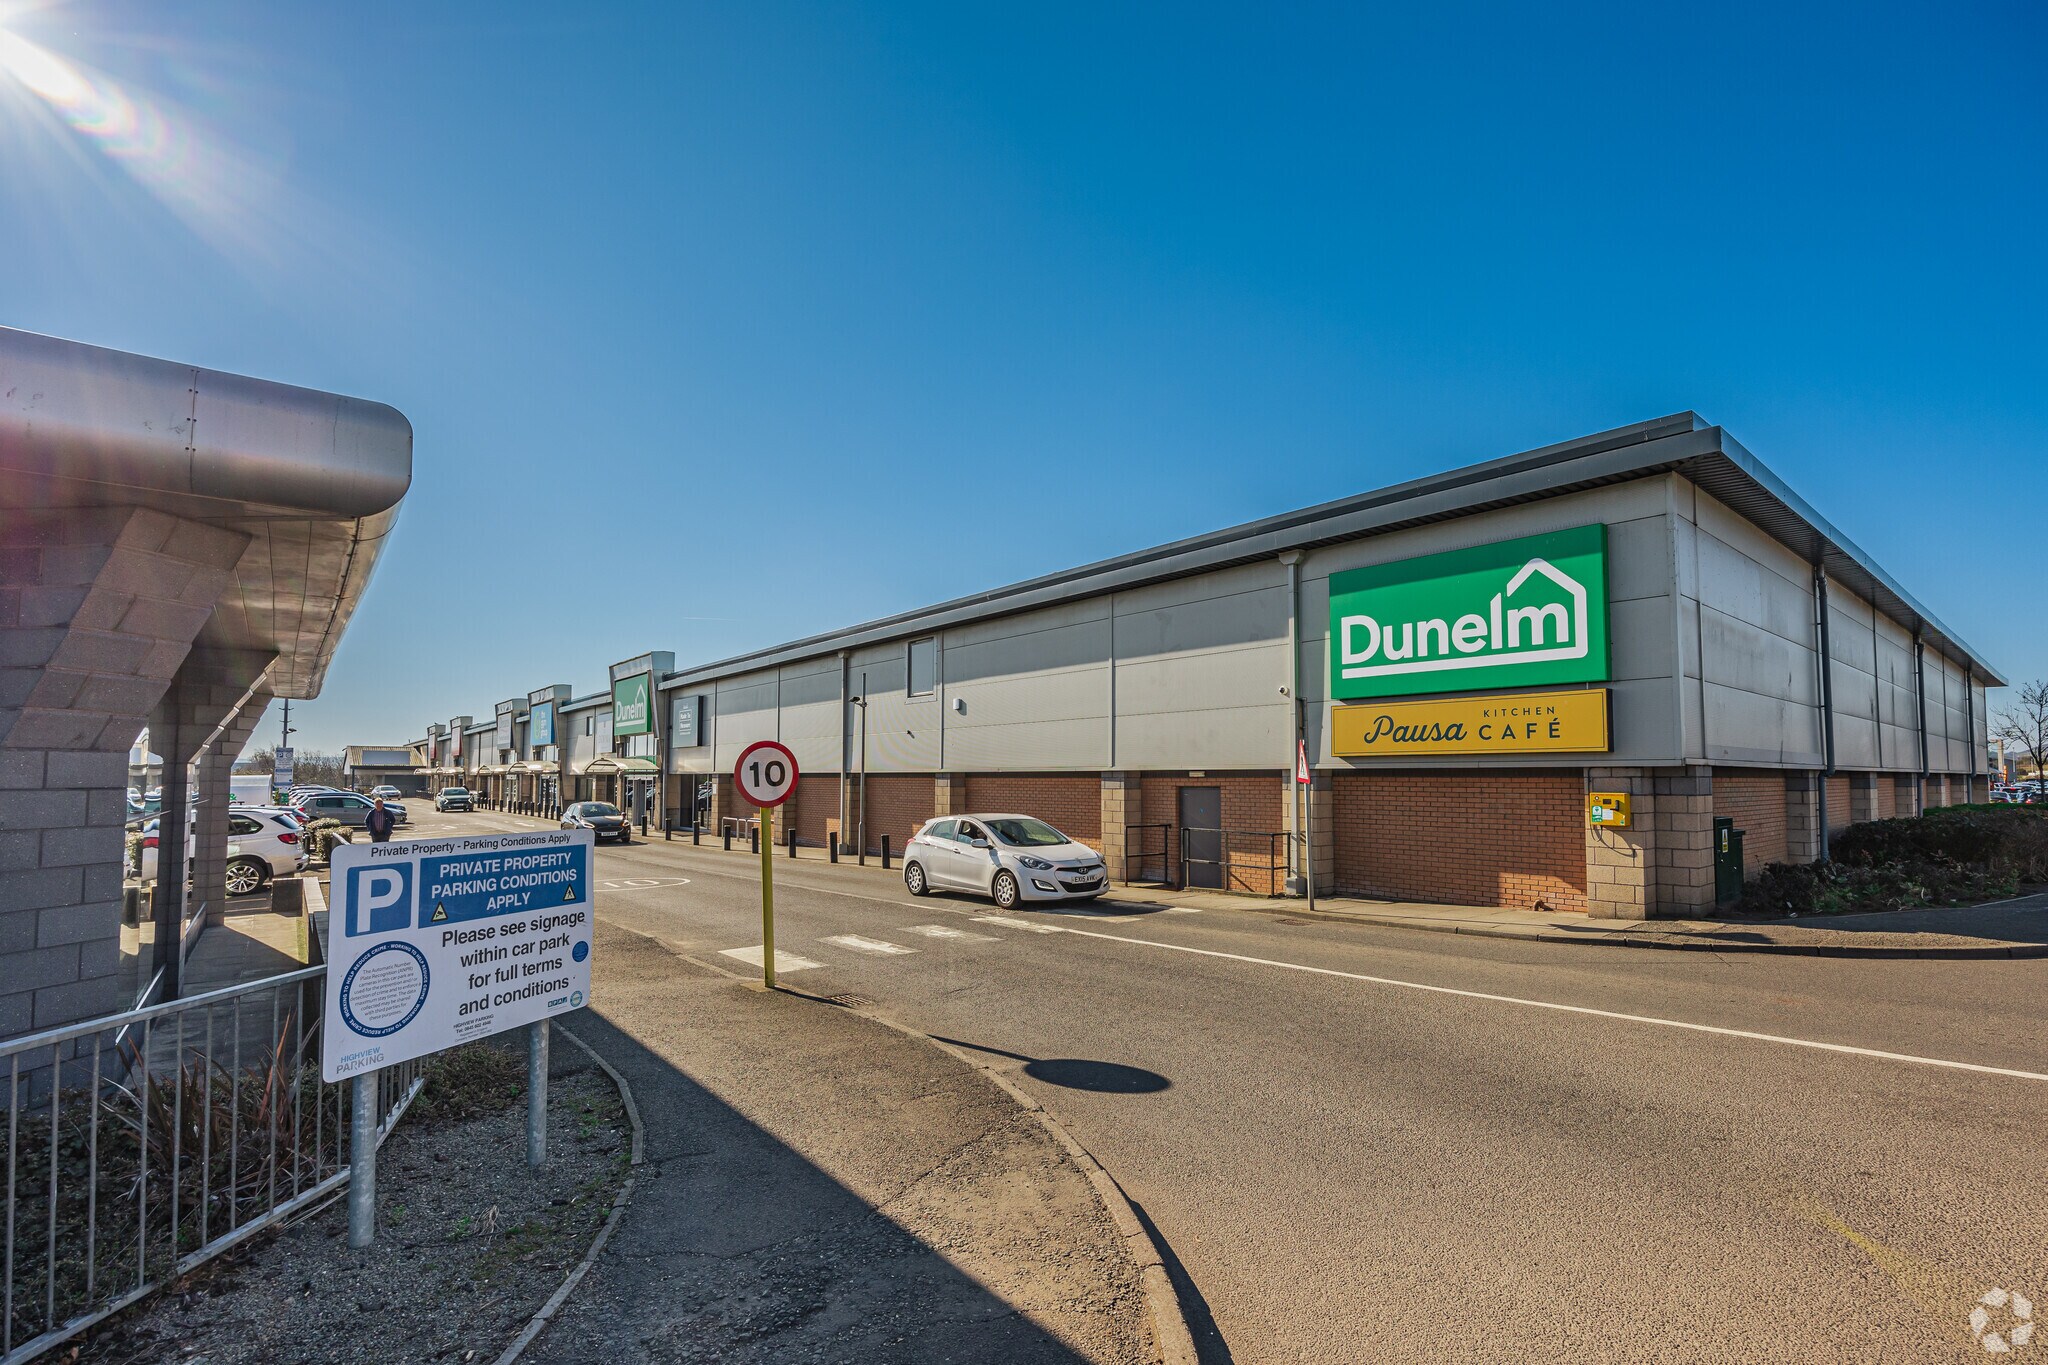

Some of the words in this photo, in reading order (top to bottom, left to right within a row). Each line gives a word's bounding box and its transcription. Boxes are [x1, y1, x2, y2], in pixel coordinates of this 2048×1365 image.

[1341, 592, 1569, 665] Dunelm
[616, 700, 644, 720] Dunelm
[1483, 706, 1556, 718] KITCHEN
[1363, 715, 1468, 744] Pausa
[1478, 718, 1561, 741] CAFÉ
[750, 760, 786, 787] 10
[371, 845, 409, 858] Private
[412, 843, 456, 856] Property
[463, 838, 498, 850] Parking
[500, 836, 546, 847] Conditions
[548, 834, 571, 845] Apply
[440, 858, 500, 878] PRIVATE
[504, 852, 572, 871] PROPERTY
[431, 878, 497, 899] PARKING
[500, 868, 577, 890] CONDITIONS
[603, 879, 660, 888] 10
[357, 868, 404, 933] P
[486, 892, 531, 910] APPLY
[442, 926, 496, 948] Please
[500, 921, 527, 937] see
[530, 911, 586, 932] signage
[460, 946, 508, 968] within
[512, 942, 536, 957] car
[539, 932, 571, 955] park
[468, 972, 492, 990] for
[494, 964, 518, 984] full
[522, 957, 563, 977] terms
[458, 994, 489, 1016] and
[494, 976, 569, 1008] conditions
[336, 1054, 384, 1074] PARKING
[340, 1046, 381, 1063] HIGHVIEW
